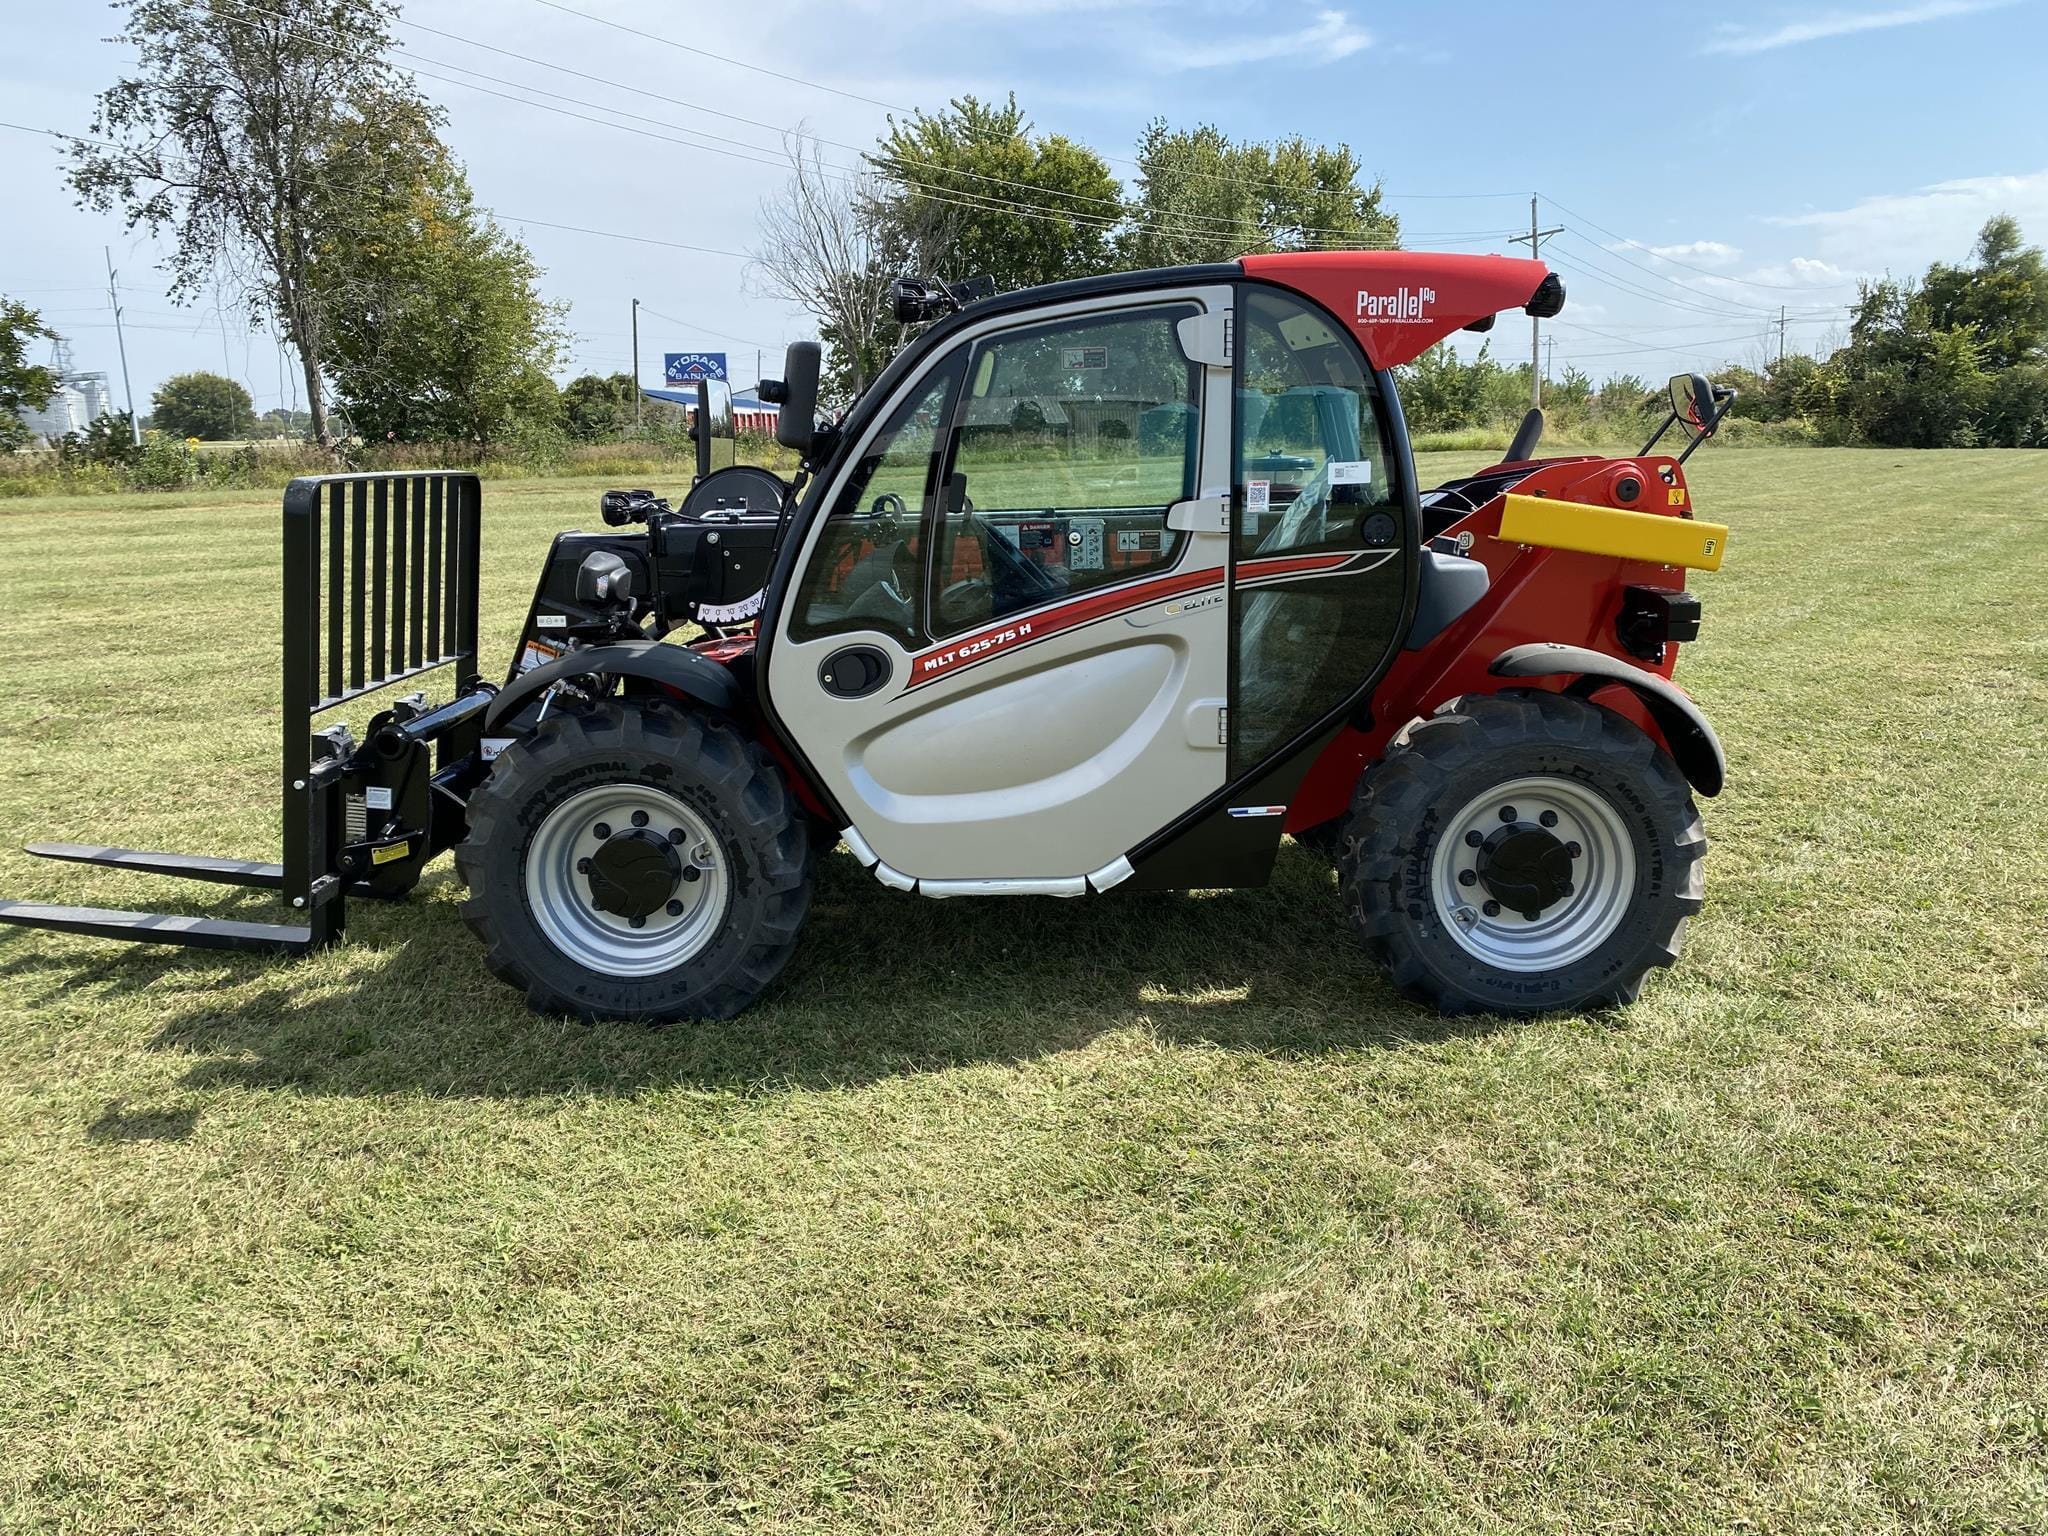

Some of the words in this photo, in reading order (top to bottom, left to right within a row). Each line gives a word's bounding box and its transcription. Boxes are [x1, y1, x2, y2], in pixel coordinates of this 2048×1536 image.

[1356, 287, 1423, 318] Parallel
[1423, 287, 1435, 304] Ag
[667, 354, 725, 377] STORAGE
[675, 372, 718, 380] BANKS
[1183, 592, 1224, 611] ELITE
[924, 651, 956, 672] MLT
[959, 629, 1017, 658] 625-75
[1019, 623, 1032, 636] H
